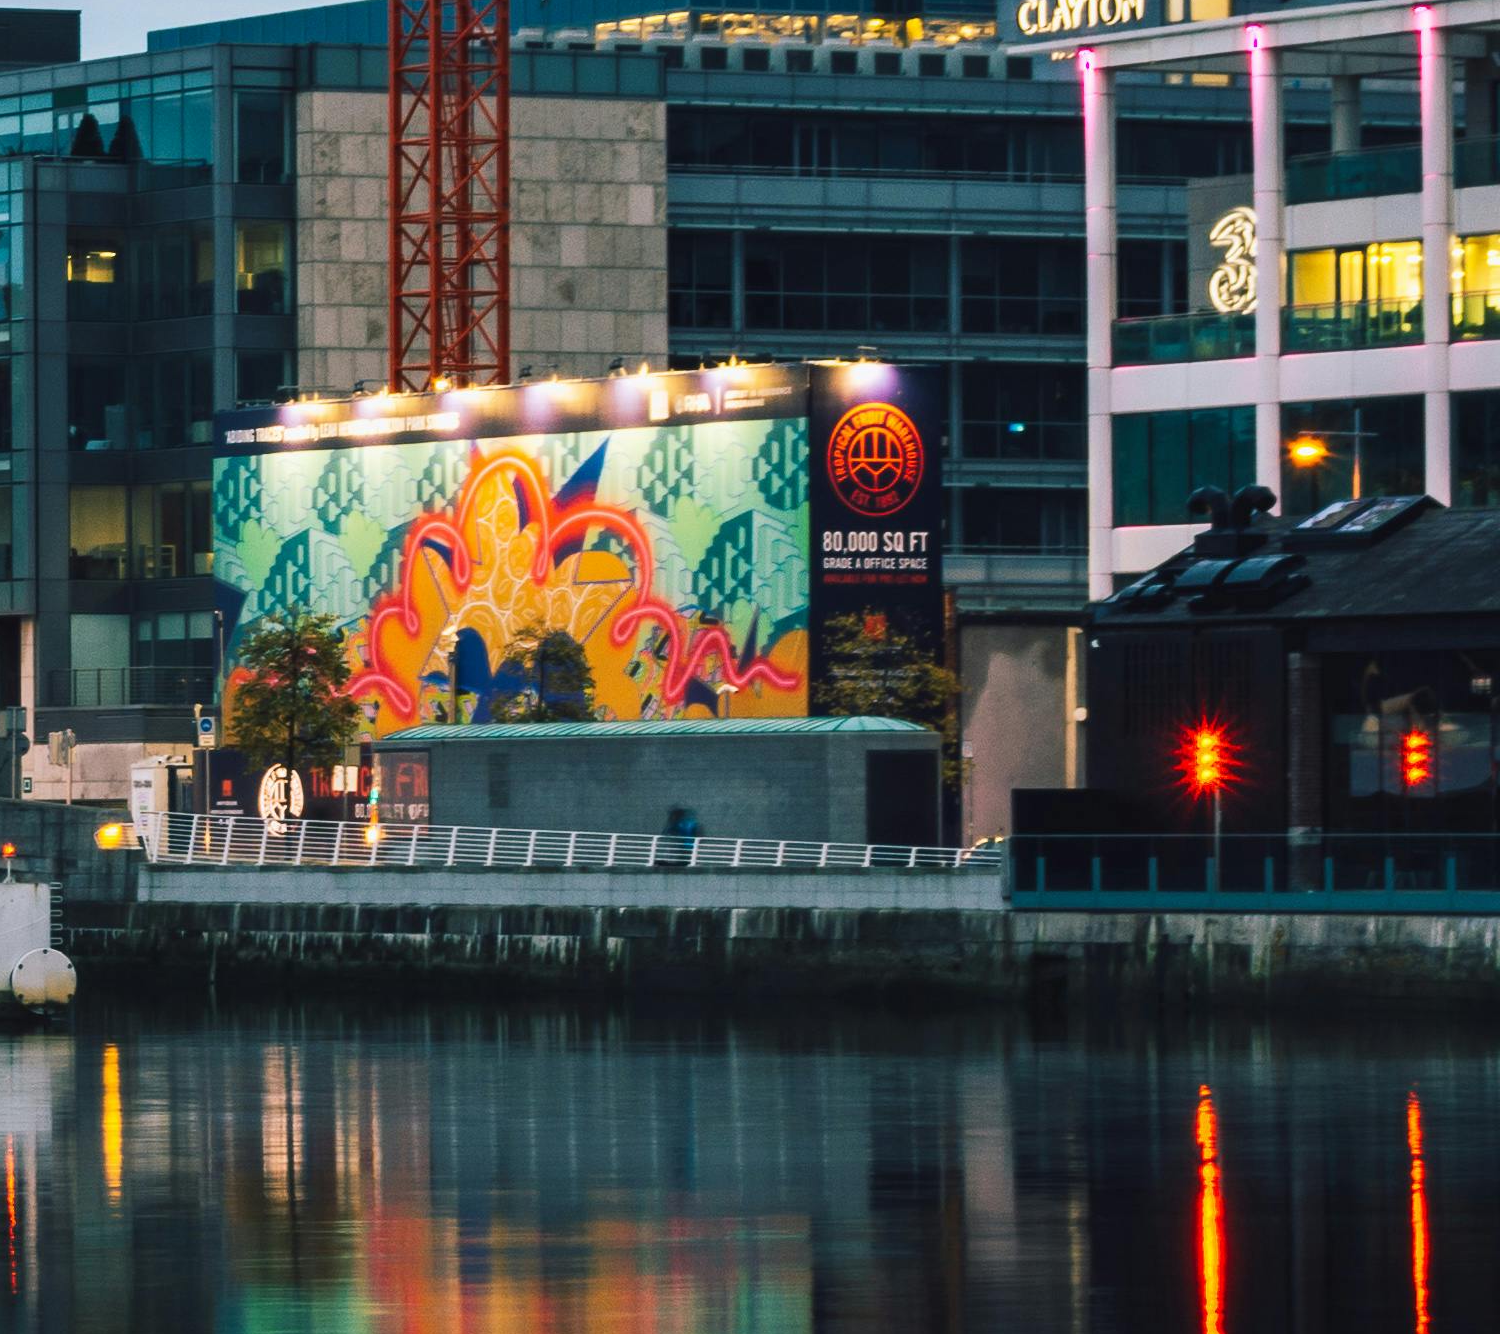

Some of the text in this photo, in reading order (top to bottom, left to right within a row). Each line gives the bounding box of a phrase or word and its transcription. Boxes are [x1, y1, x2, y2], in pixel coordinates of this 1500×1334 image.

[823, 531, 928, 554] 80,000 SQ FT
[823, 557, 927, 569] GRADE A OFFICE SPACE
